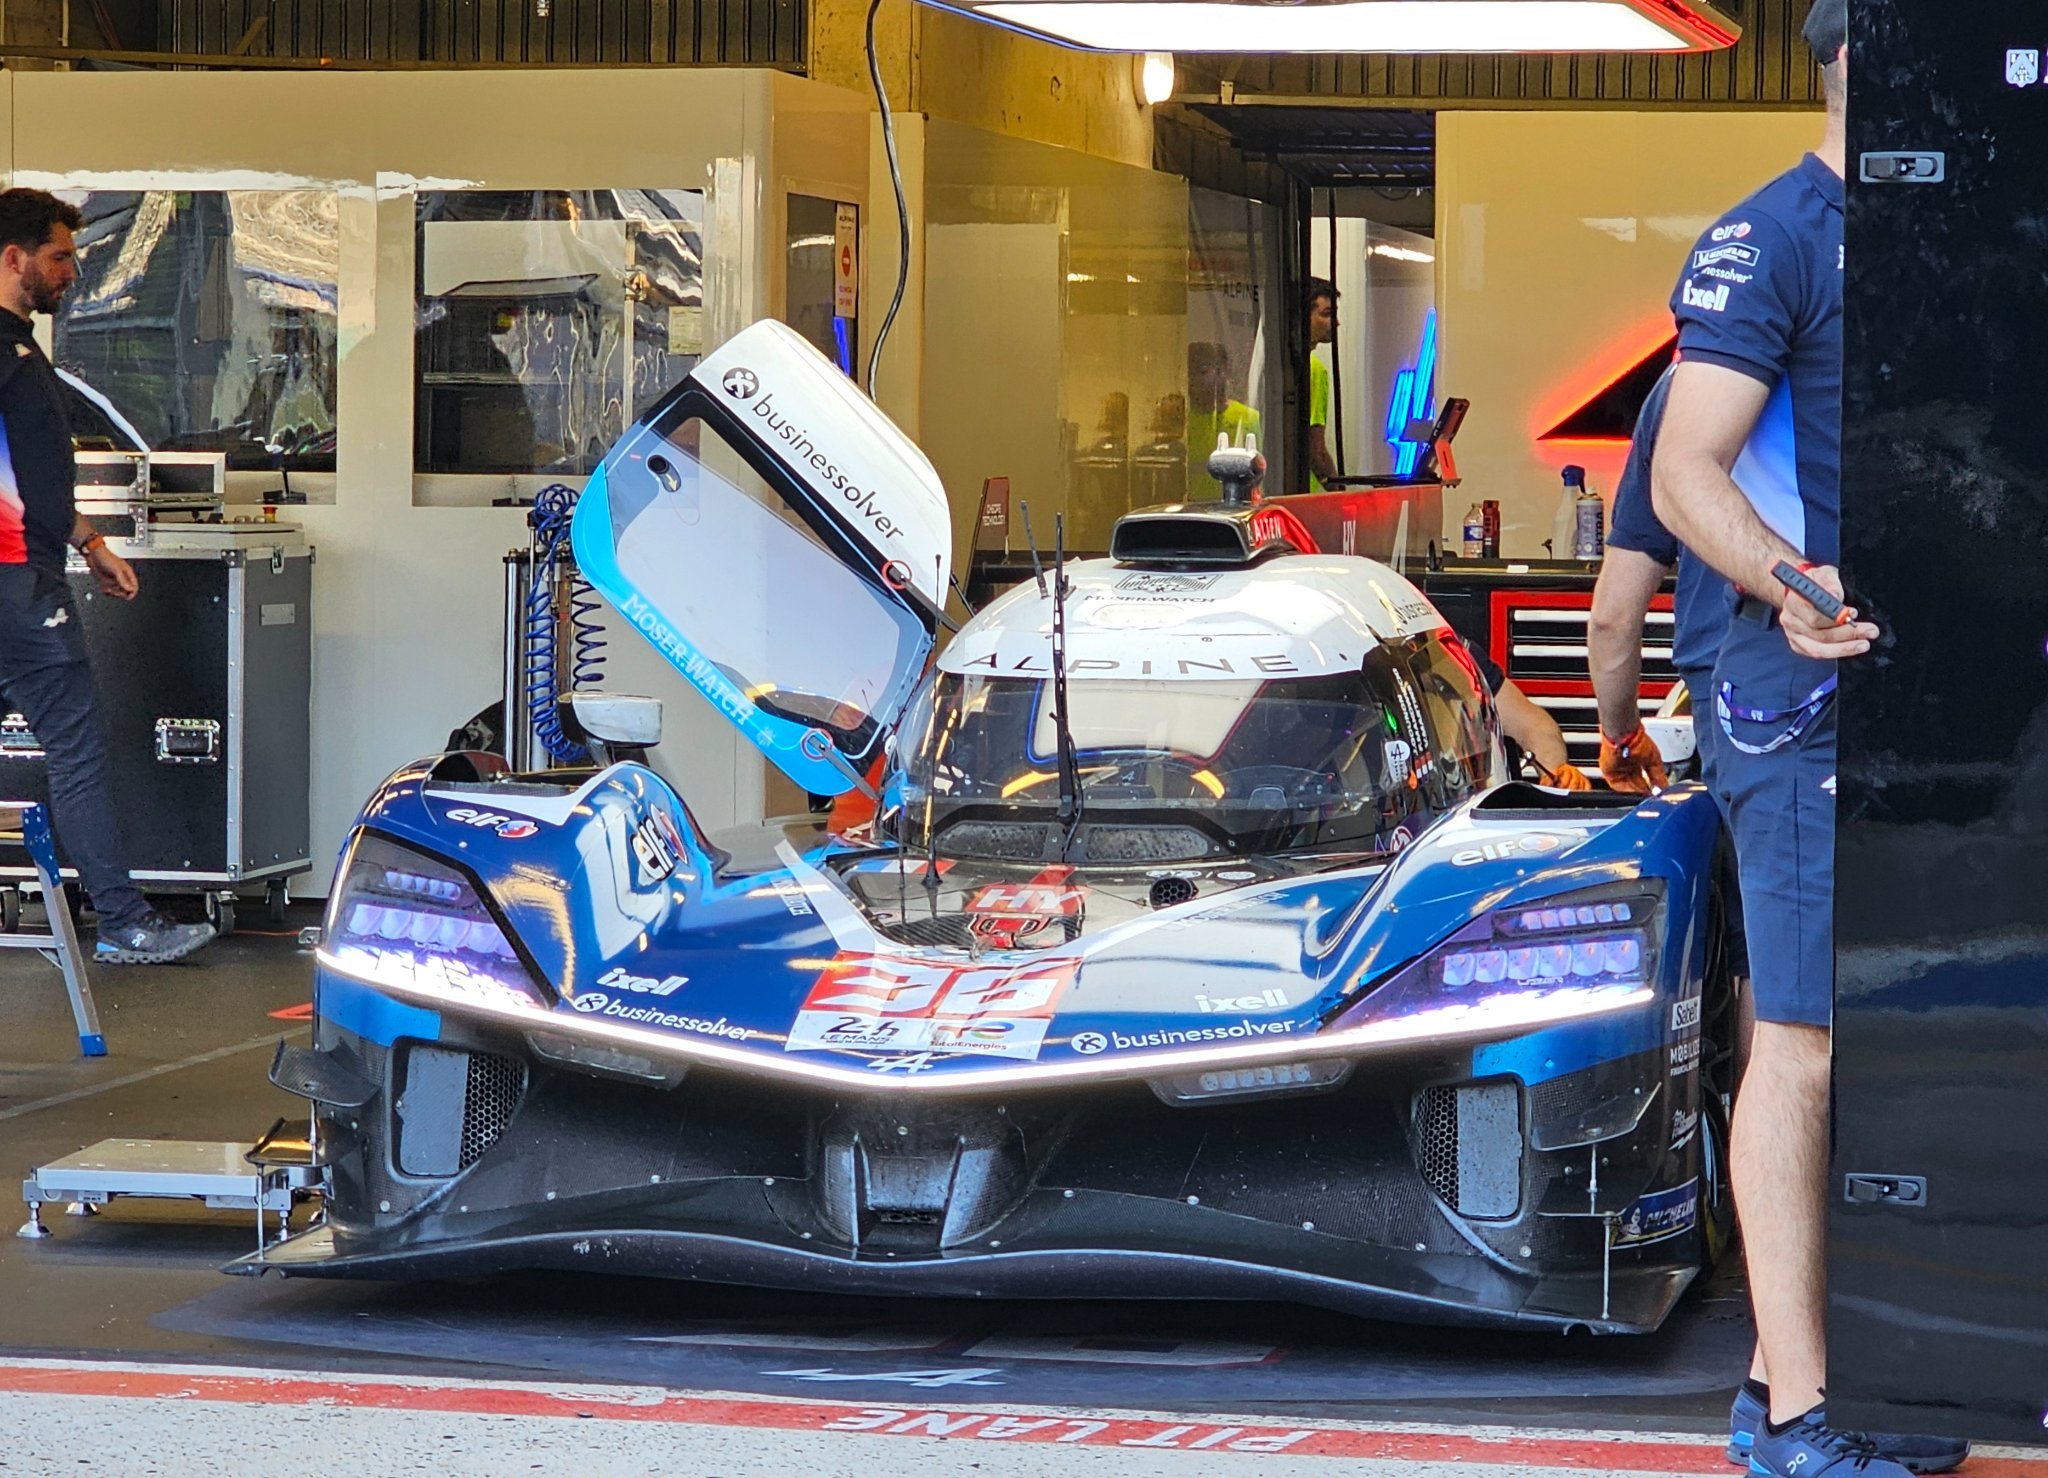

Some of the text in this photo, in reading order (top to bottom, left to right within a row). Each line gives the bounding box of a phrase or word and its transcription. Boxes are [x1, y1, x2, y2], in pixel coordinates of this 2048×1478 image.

[1711, 223, 1735, 241] elf
[1682, 279, 1730, 312] ixell
[752, 393, 903, 539] businessolver
[621, 593, 755, 725] MOSER.WATCH
[963, 652, 1299, 676] ALPINE
[445, 808, 502, 828] elf
[631, 816, 674, 881] elf
[1451, 840, 1516, 866] elf
[976, 889, 1086, 909] HY
[597, 968, 689, 996] ixell
[1195, 988, 1288, 1013] ixell
[603, 1000, 758, 1041] businessolver
[1112, 1019, 1295, 1049] businessolver
[929, 1041, 1007, 1050] TotalEnergies
[824, 1408, 1317, 1453] PIT LANE
